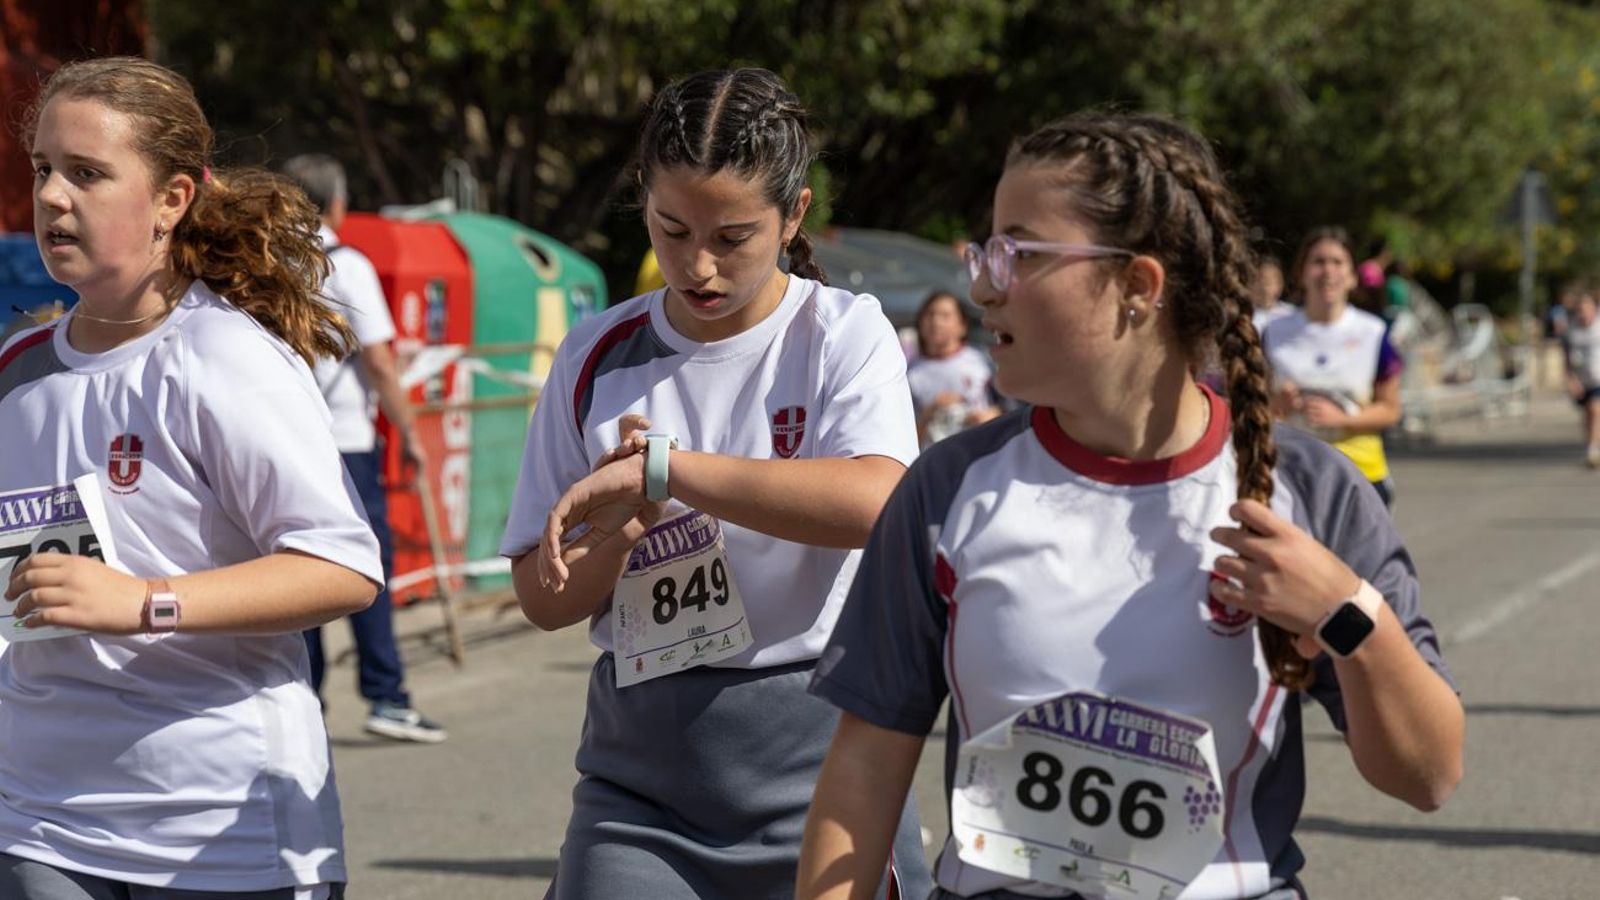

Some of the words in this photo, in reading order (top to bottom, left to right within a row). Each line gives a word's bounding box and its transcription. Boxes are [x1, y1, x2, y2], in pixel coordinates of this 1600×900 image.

[62, 502, 76, 516] LA
[0, 534, 106, 577] 75
[652, 557, 729, 625] 849
[687, 624, 707, 638] LAURA
[1109, 708, 1168, 739] CARRERA
[1117, 728, 1138, 749] LA
[1016, 752, 1167, 839] 866
